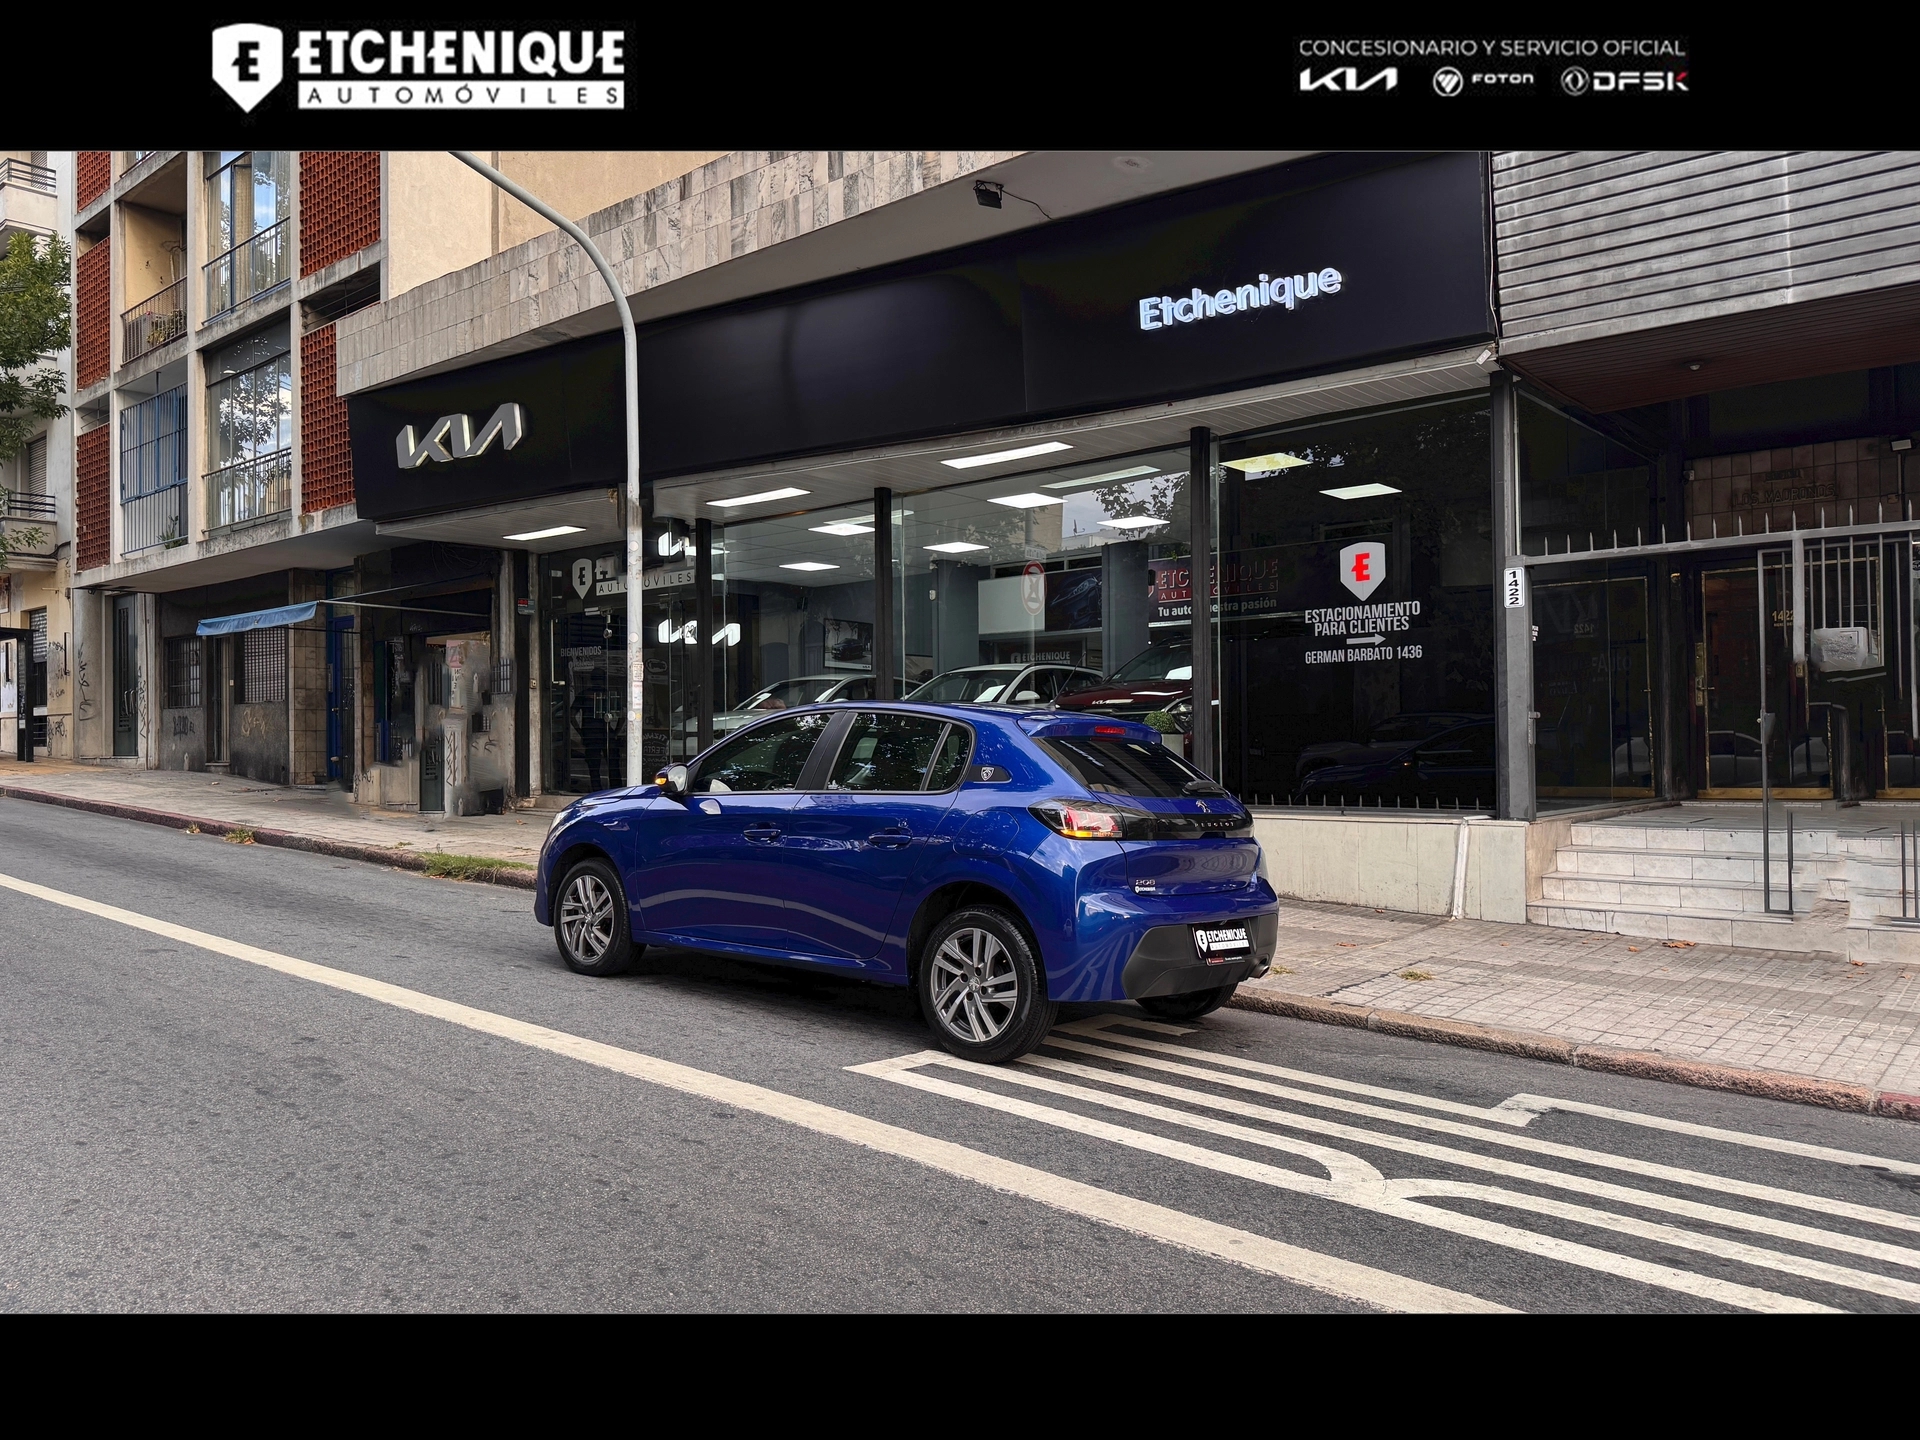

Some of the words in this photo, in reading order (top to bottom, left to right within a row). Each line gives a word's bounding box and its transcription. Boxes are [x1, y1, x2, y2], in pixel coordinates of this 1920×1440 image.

[1139, 267, 1342, 331] Etchenique
[396, 402, 522, 469] KIA
[1508, 570, 1519, 606] 1422
[1158, 606, 1169, 617] Tu
[1241, 597, 1277, 612] pasión
[1304, 600, 1421, 624] ESTACIONAMIENTO
[1314, 621, 1347, 636] PARA
[1350, 616, 1410, 634] CLIENTES
[560, 646, 602, 657] BIENVENIDOS
[1022, 651, 1070, 661] ETCHENIQUE
[1305, 649, 1345, 664] GERMAN
[1347, 646, 1393, 661] BARBATO
[1397, 645, 1422, 659] 1436
[1206, 928, 1248, 943] ETCHENIQUE
